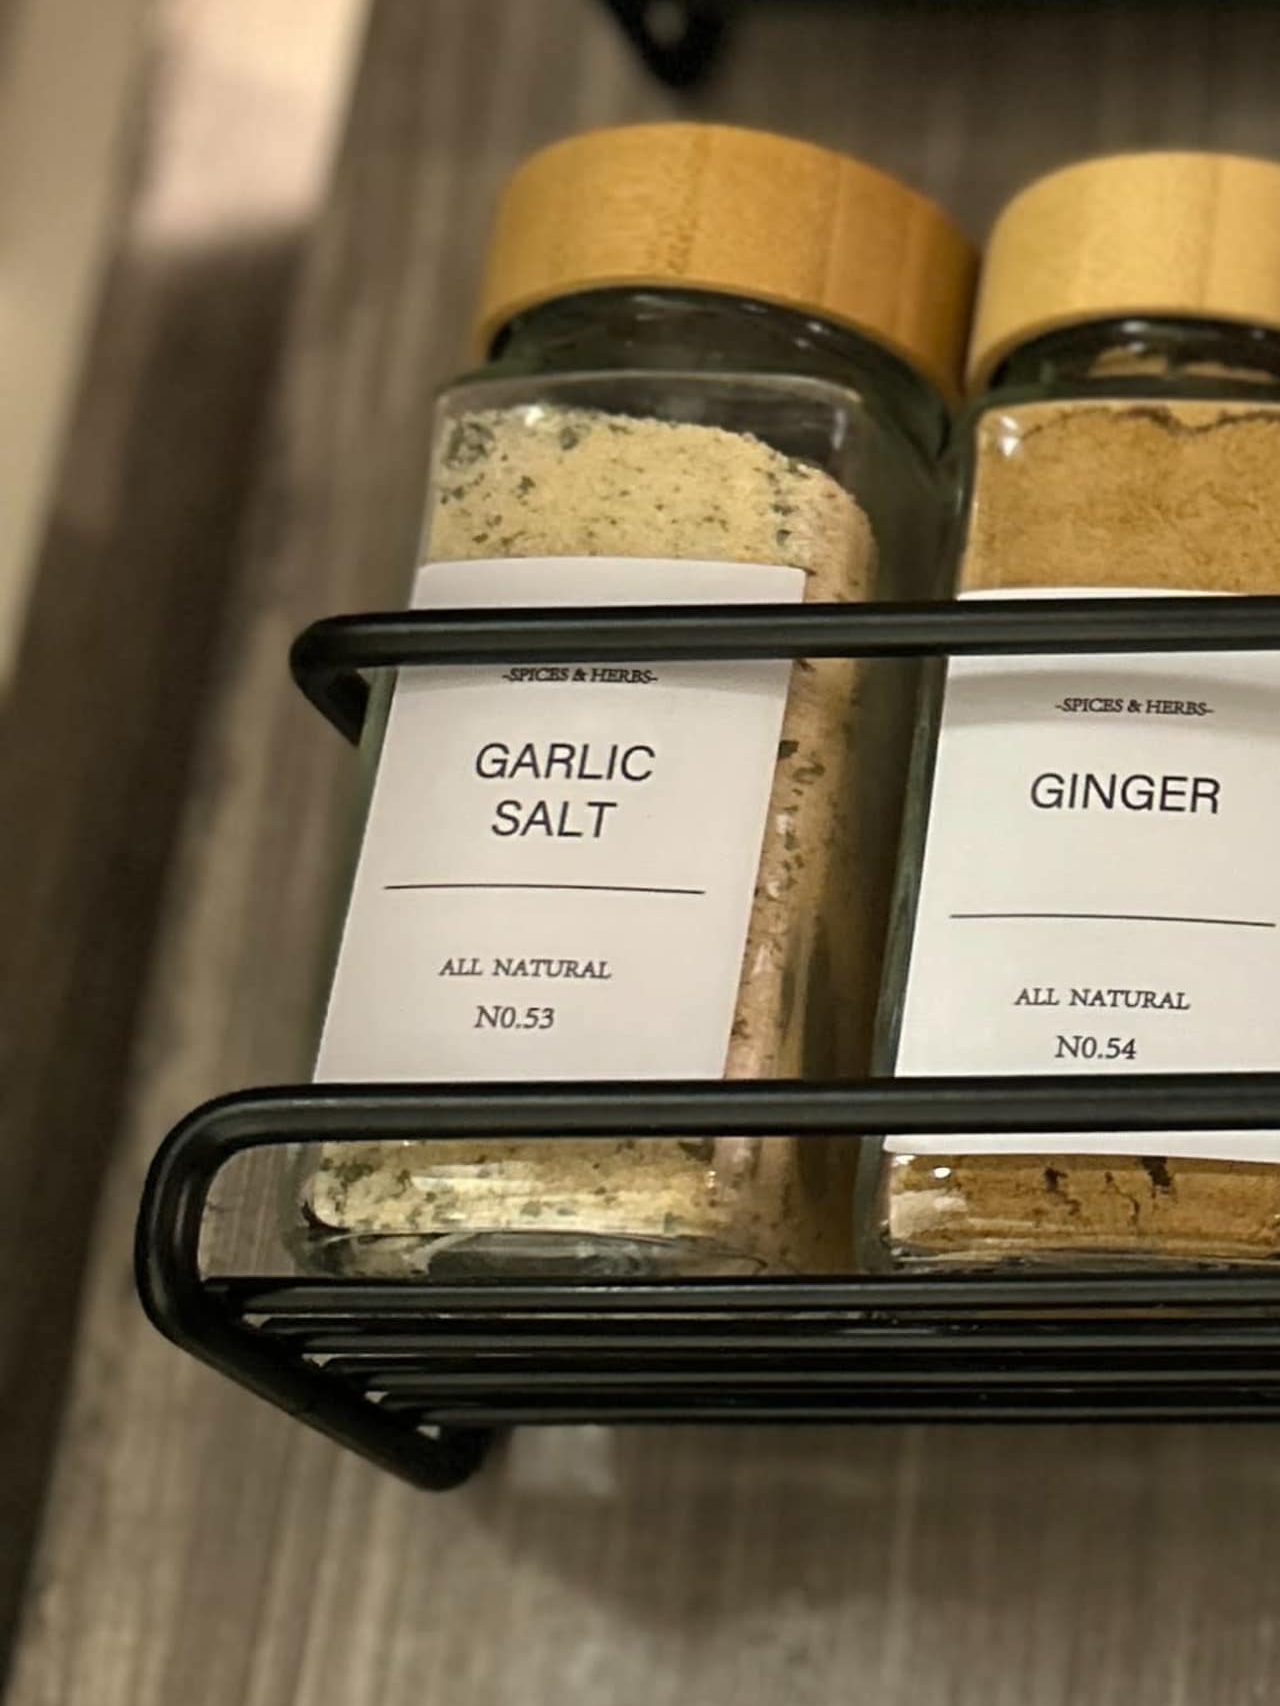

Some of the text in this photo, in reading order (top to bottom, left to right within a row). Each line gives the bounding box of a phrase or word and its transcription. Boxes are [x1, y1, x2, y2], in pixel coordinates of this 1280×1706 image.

[572, 667, 587, 681] &
[1127, 699, 1142, 713] &
[476, 743, 655, 781] GARLIC
[1031, 773, 1220, 814] GINGER
[492, 800, 618, 838] SALT
[438, 958, 612, 980] ALL NATURAL
[1014, 988, 1191, 1010] ALL NATURAL
